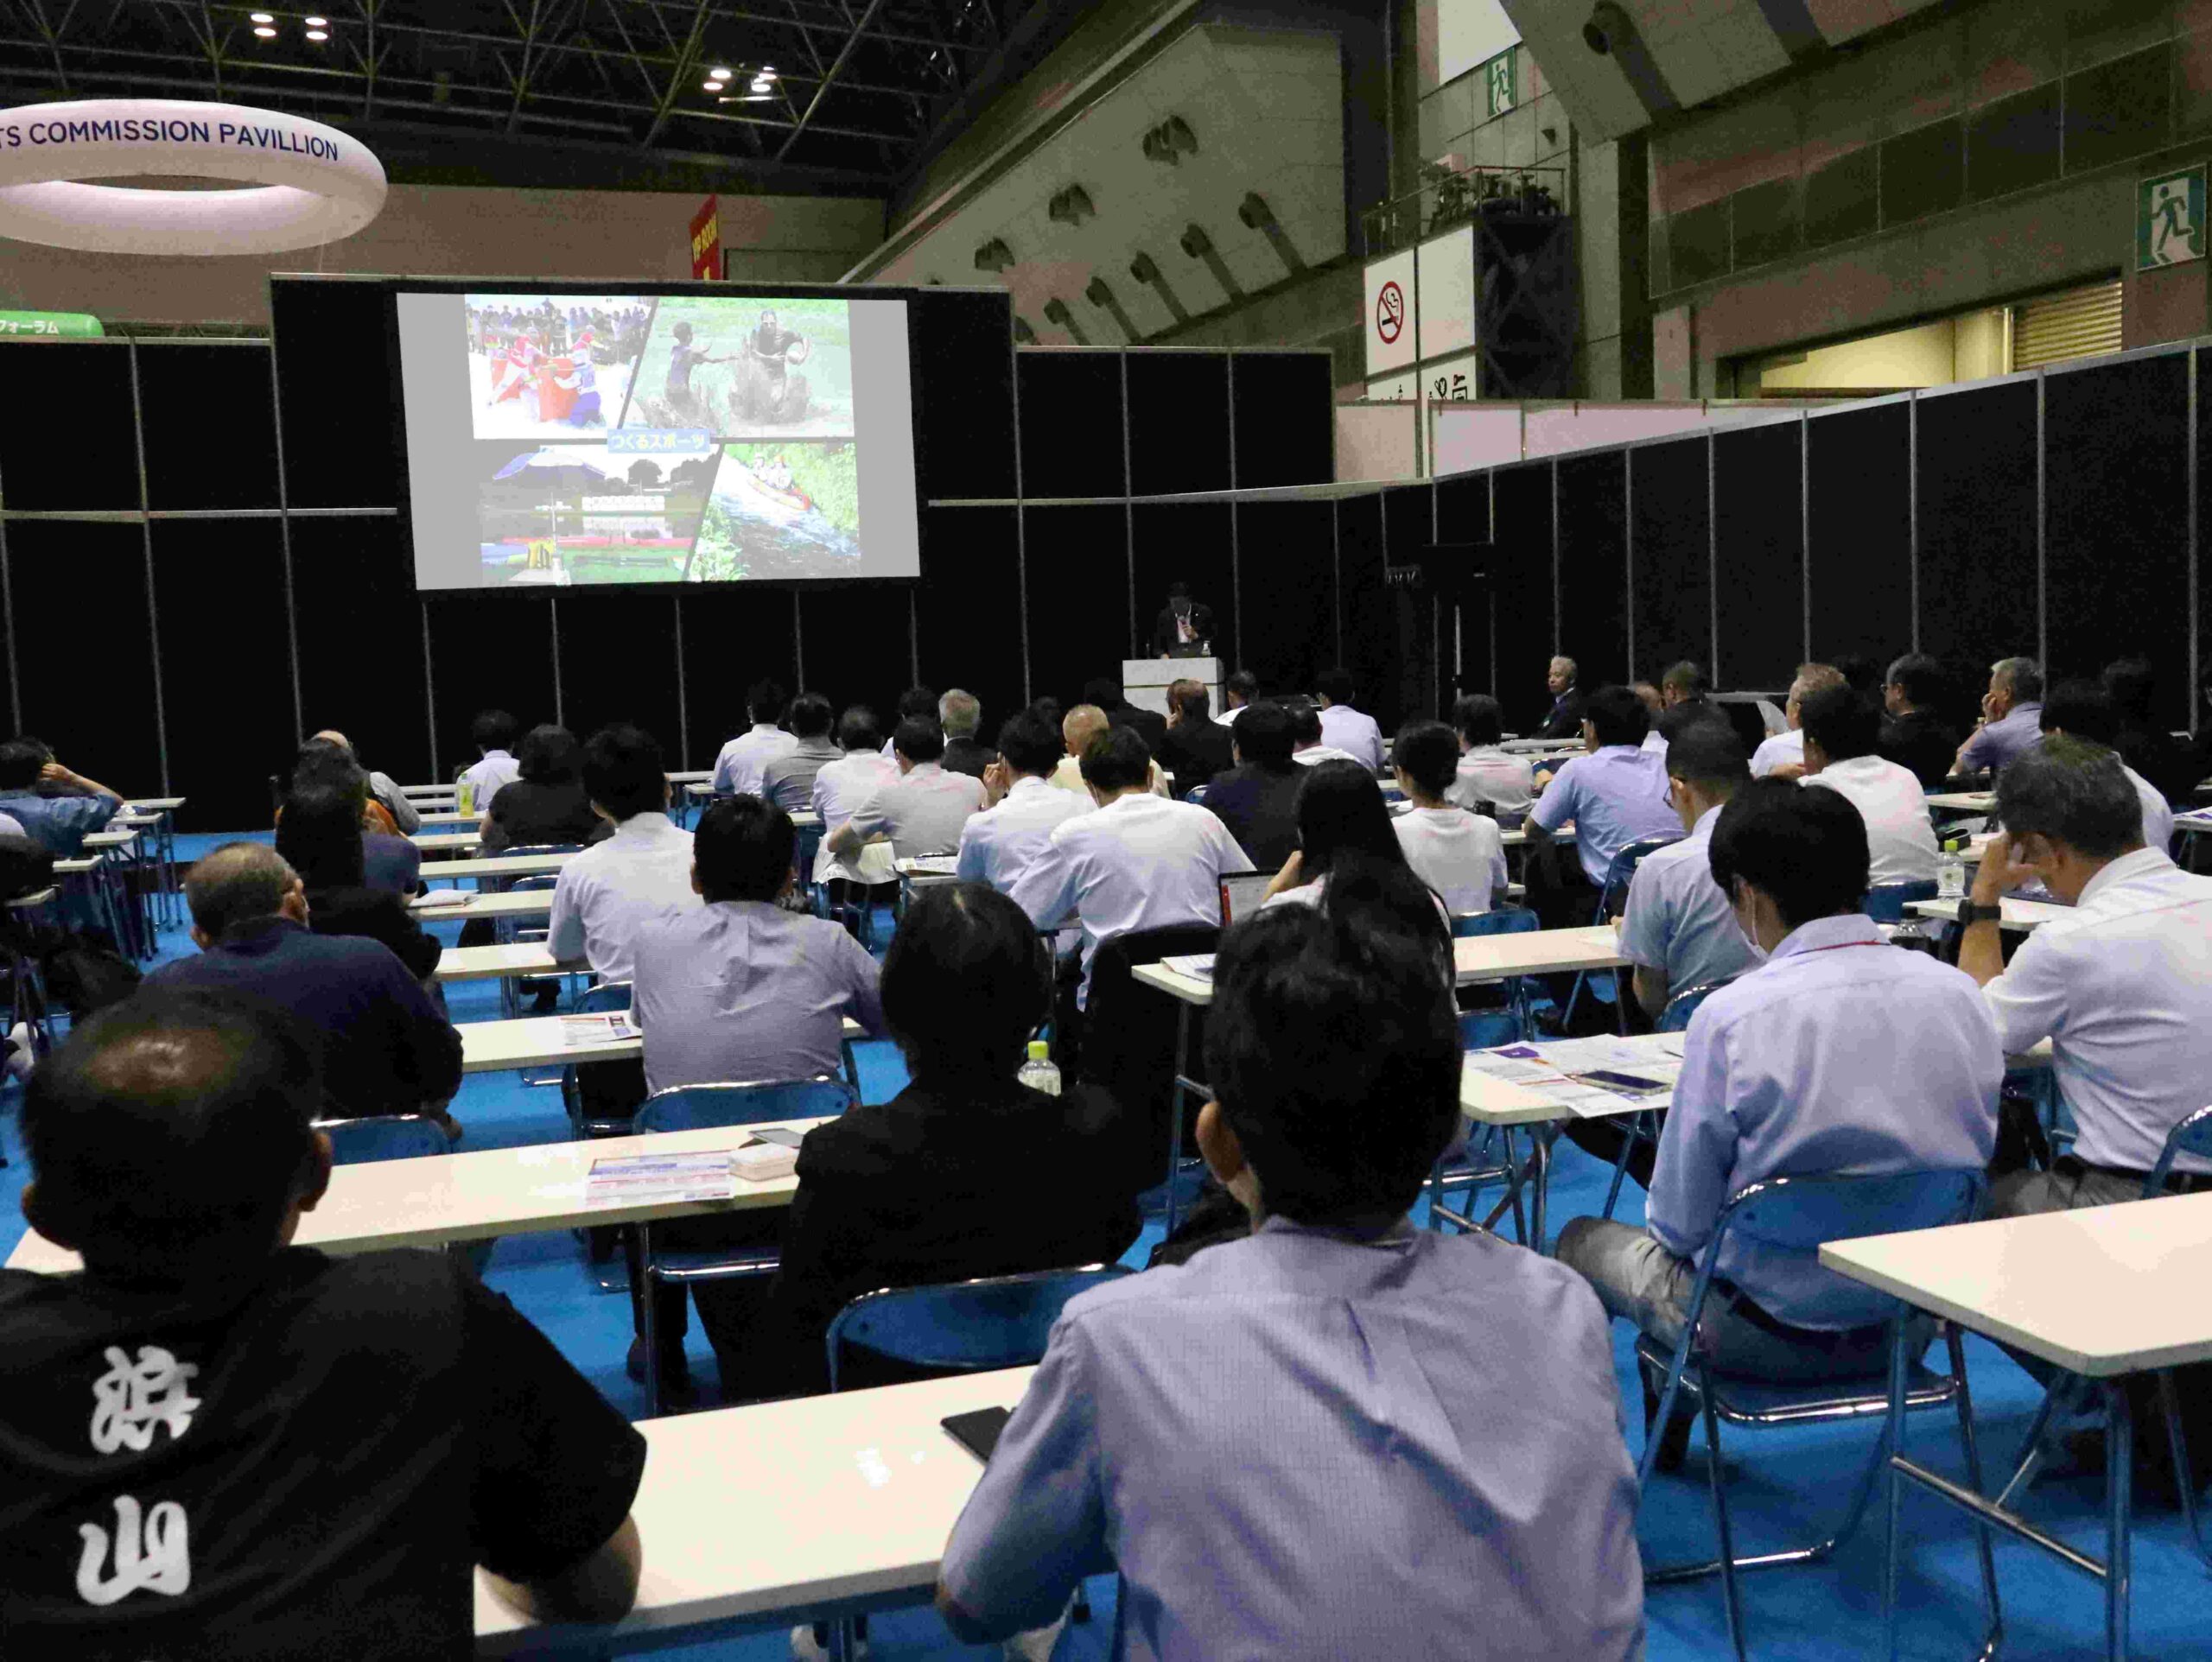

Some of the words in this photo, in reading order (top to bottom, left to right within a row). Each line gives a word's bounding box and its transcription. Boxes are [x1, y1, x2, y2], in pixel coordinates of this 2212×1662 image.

[29, 120, 209, 144] COMMISSION
[219, 124, 338, 161] PAVILLION
[610, 433, 706, 450] つくるスポーツ
